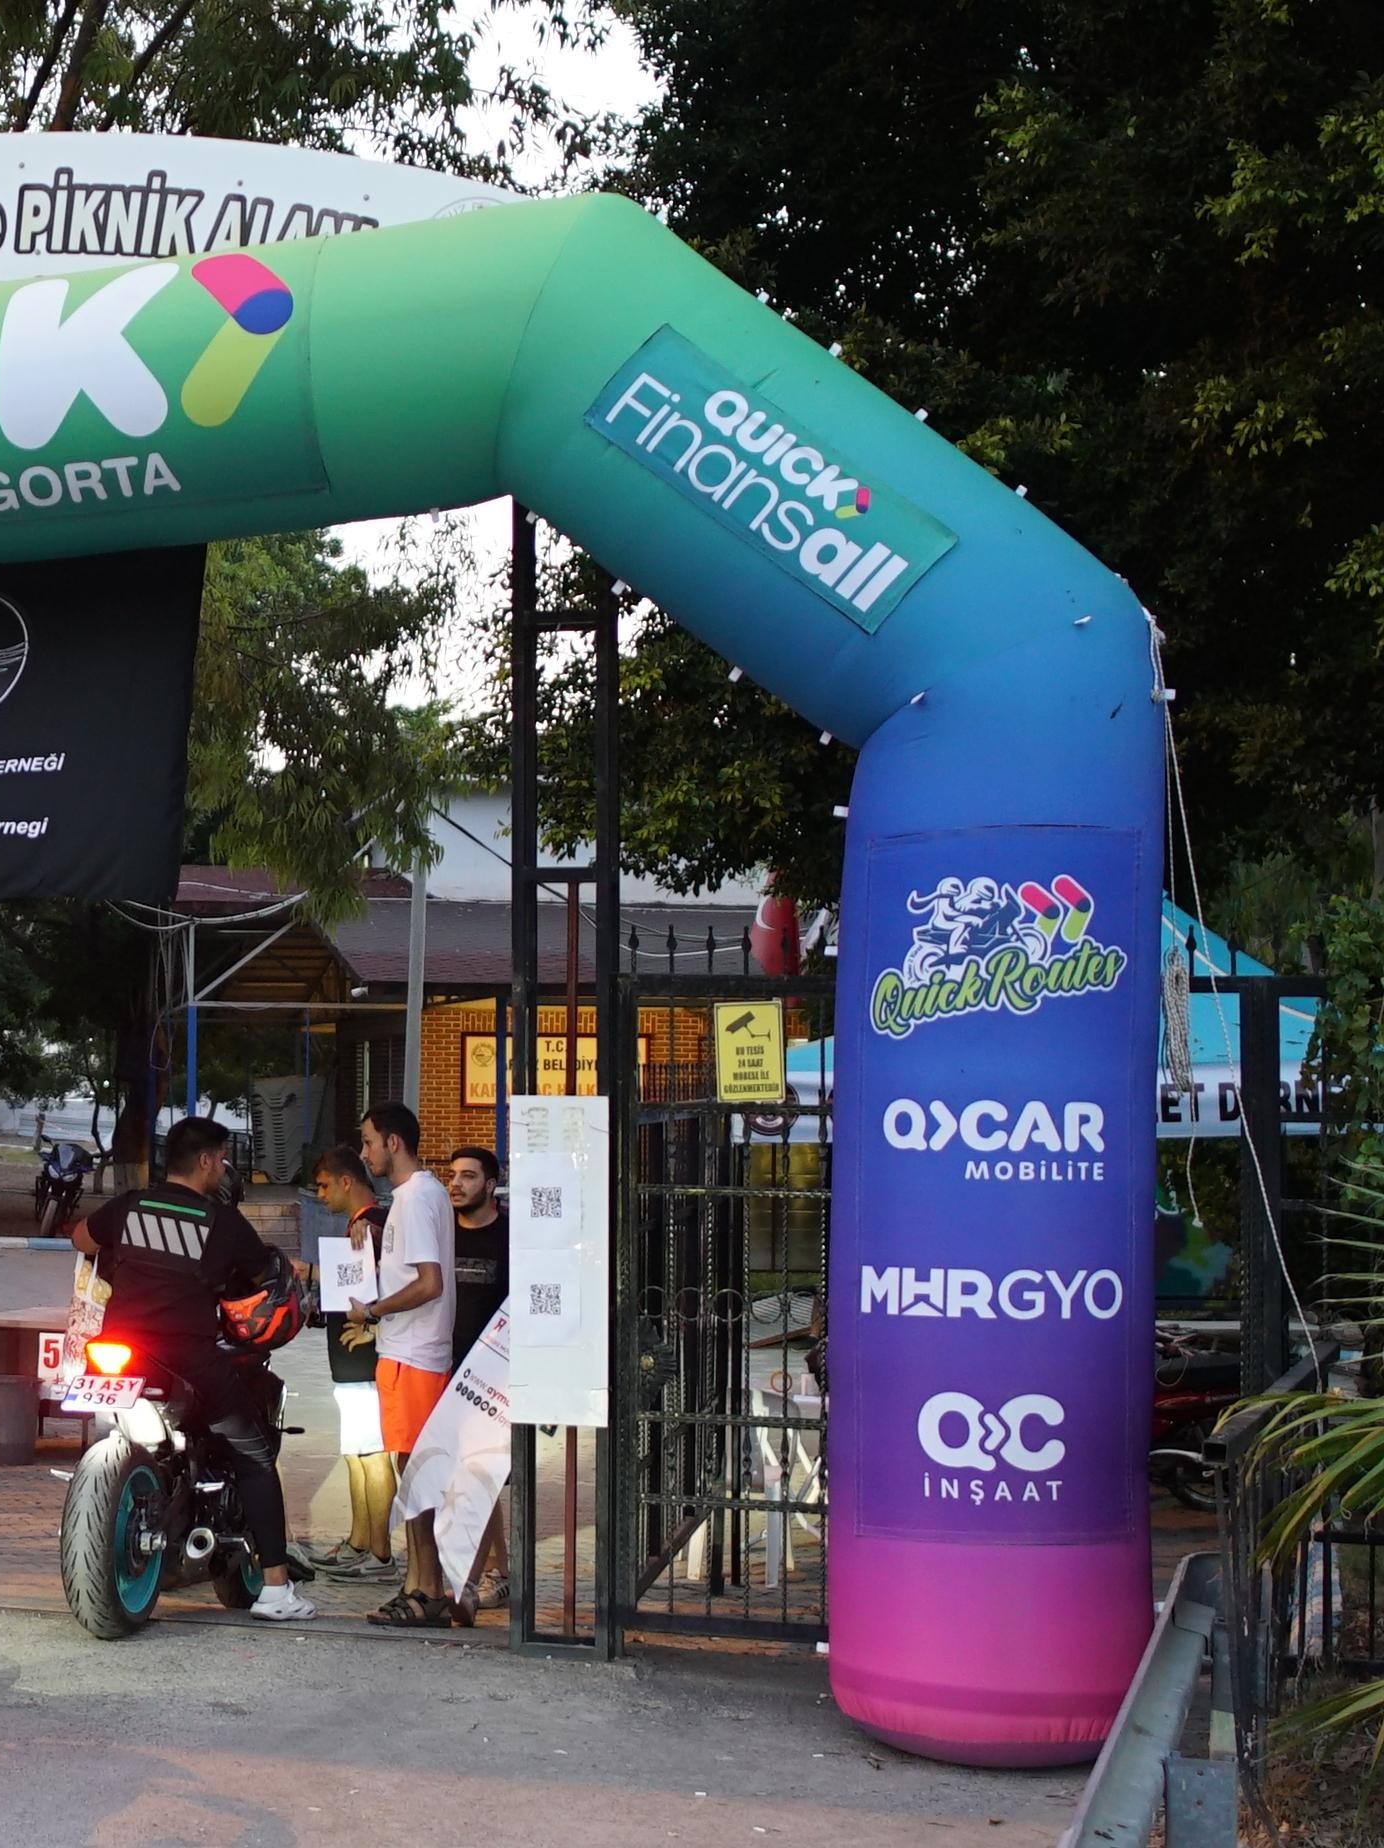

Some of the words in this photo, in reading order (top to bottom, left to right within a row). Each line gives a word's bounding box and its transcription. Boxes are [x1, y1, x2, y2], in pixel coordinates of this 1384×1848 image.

[14, 166, 204, 258] PİKNİK
[204, 194, 379, 252] ALA
[704, 390, 859, 511] QUICK
[871, 957, 986, 1037] Quick
[986, 938, 1127, 1013] Routes
[74, 1378, 95, 1390] 31
[100, 1379, 139, 1391] ASY
[83, 1392, 116, 1405] 936
[923, 1471, 1063, 1506] İNŞAAT
